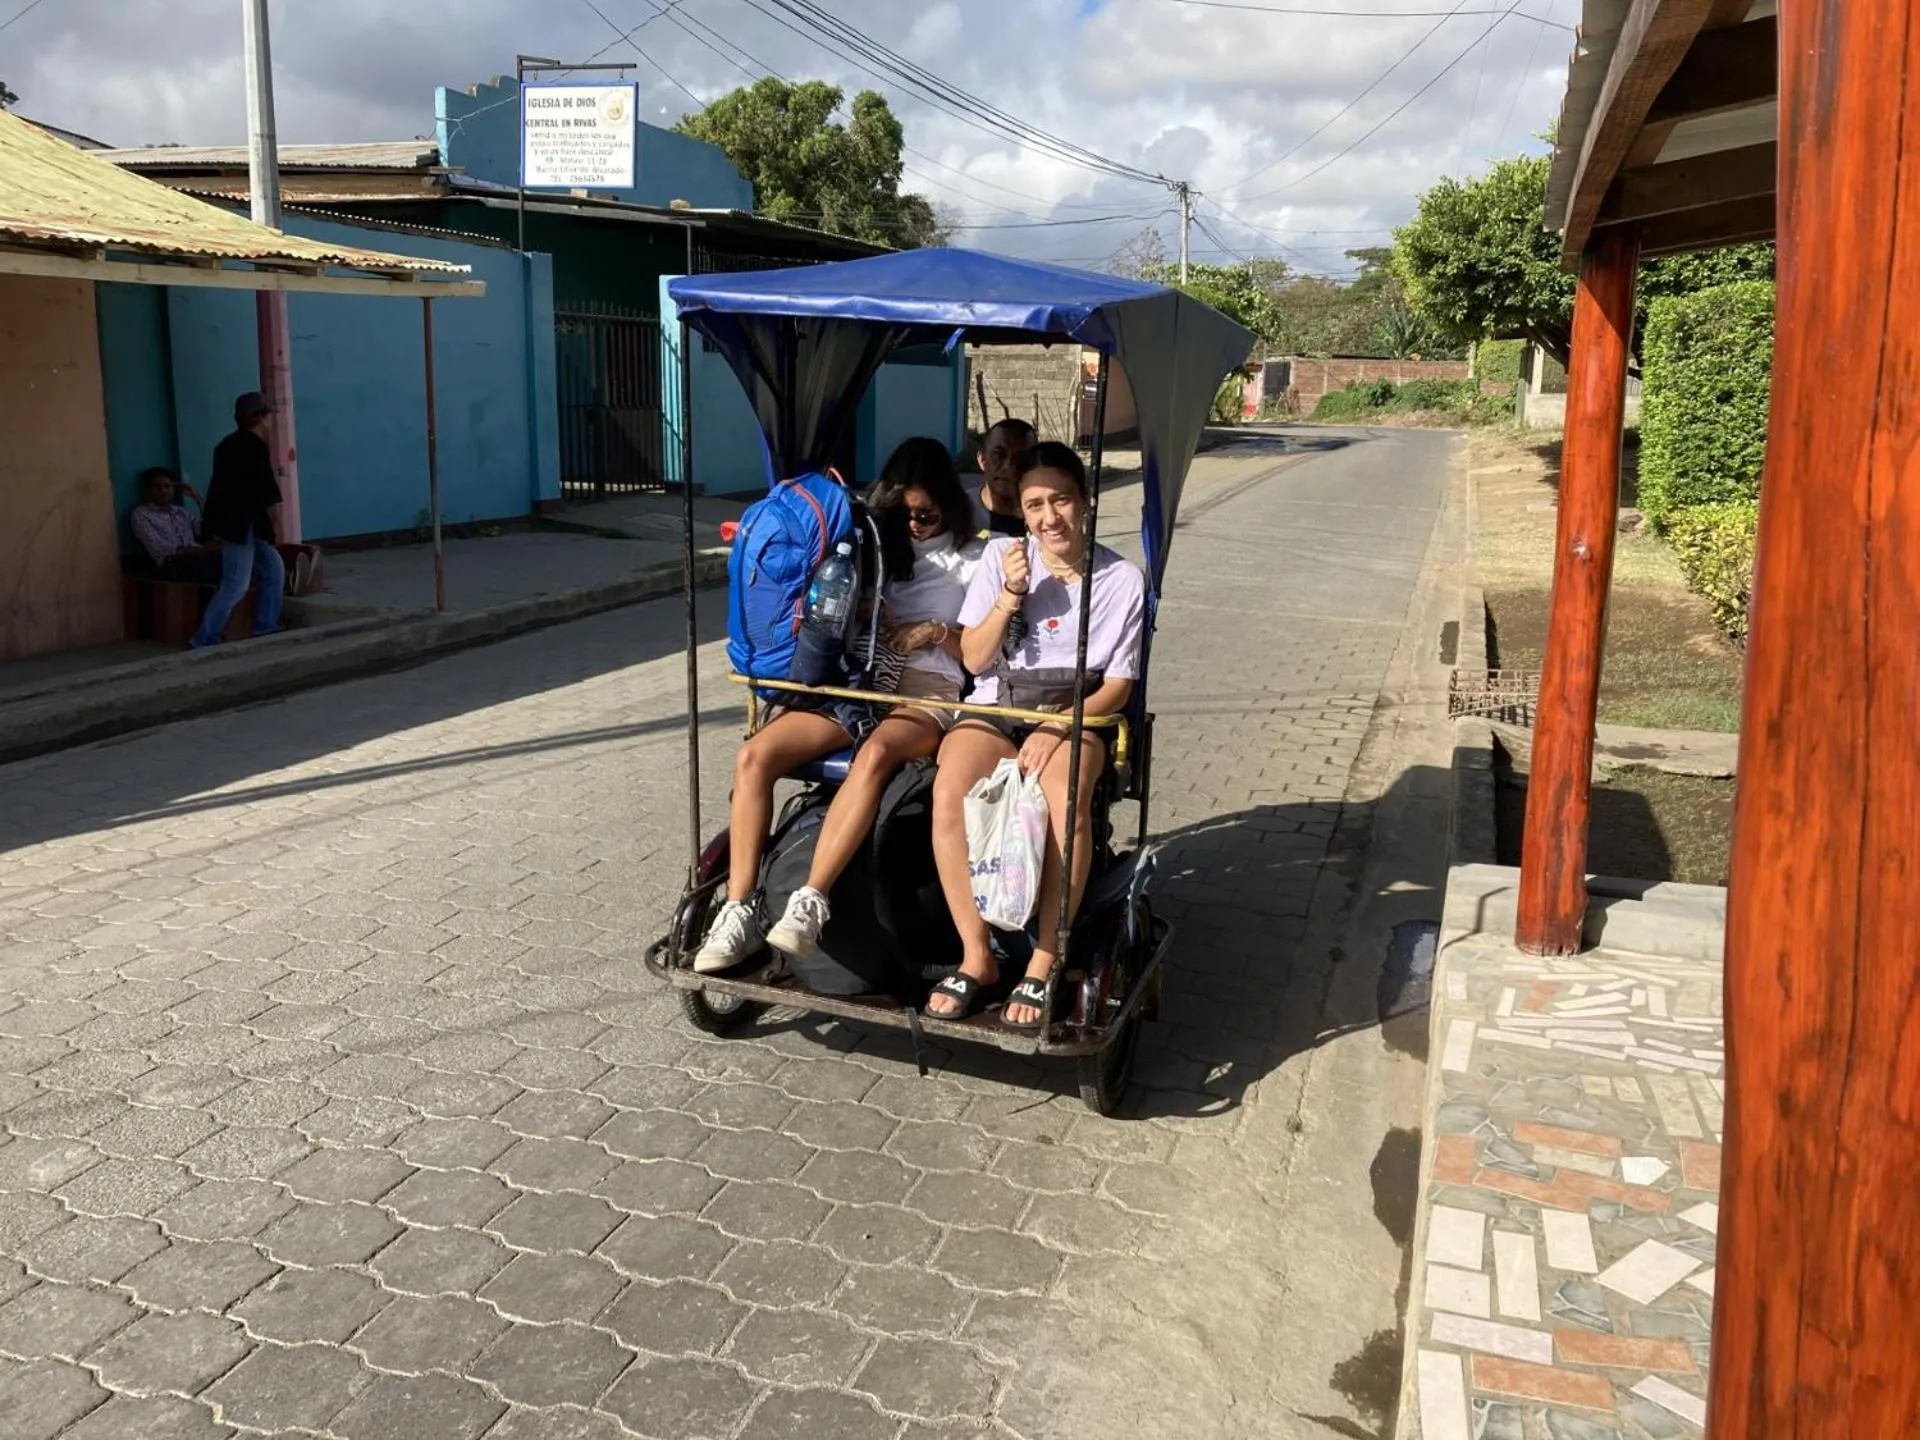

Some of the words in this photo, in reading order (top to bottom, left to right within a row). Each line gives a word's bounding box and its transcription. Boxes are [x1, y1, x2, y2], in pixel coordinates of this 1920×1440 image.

[528, 98, 560, 108] IGLESIA
[563, 98, 573, 108] DE
[576, 97, 596, 108] DIOS
[526, 118, 558, 128] CENTRAL
[562, 118, 572, 128] EN
[574, 118, 597, 128] RIVAS
